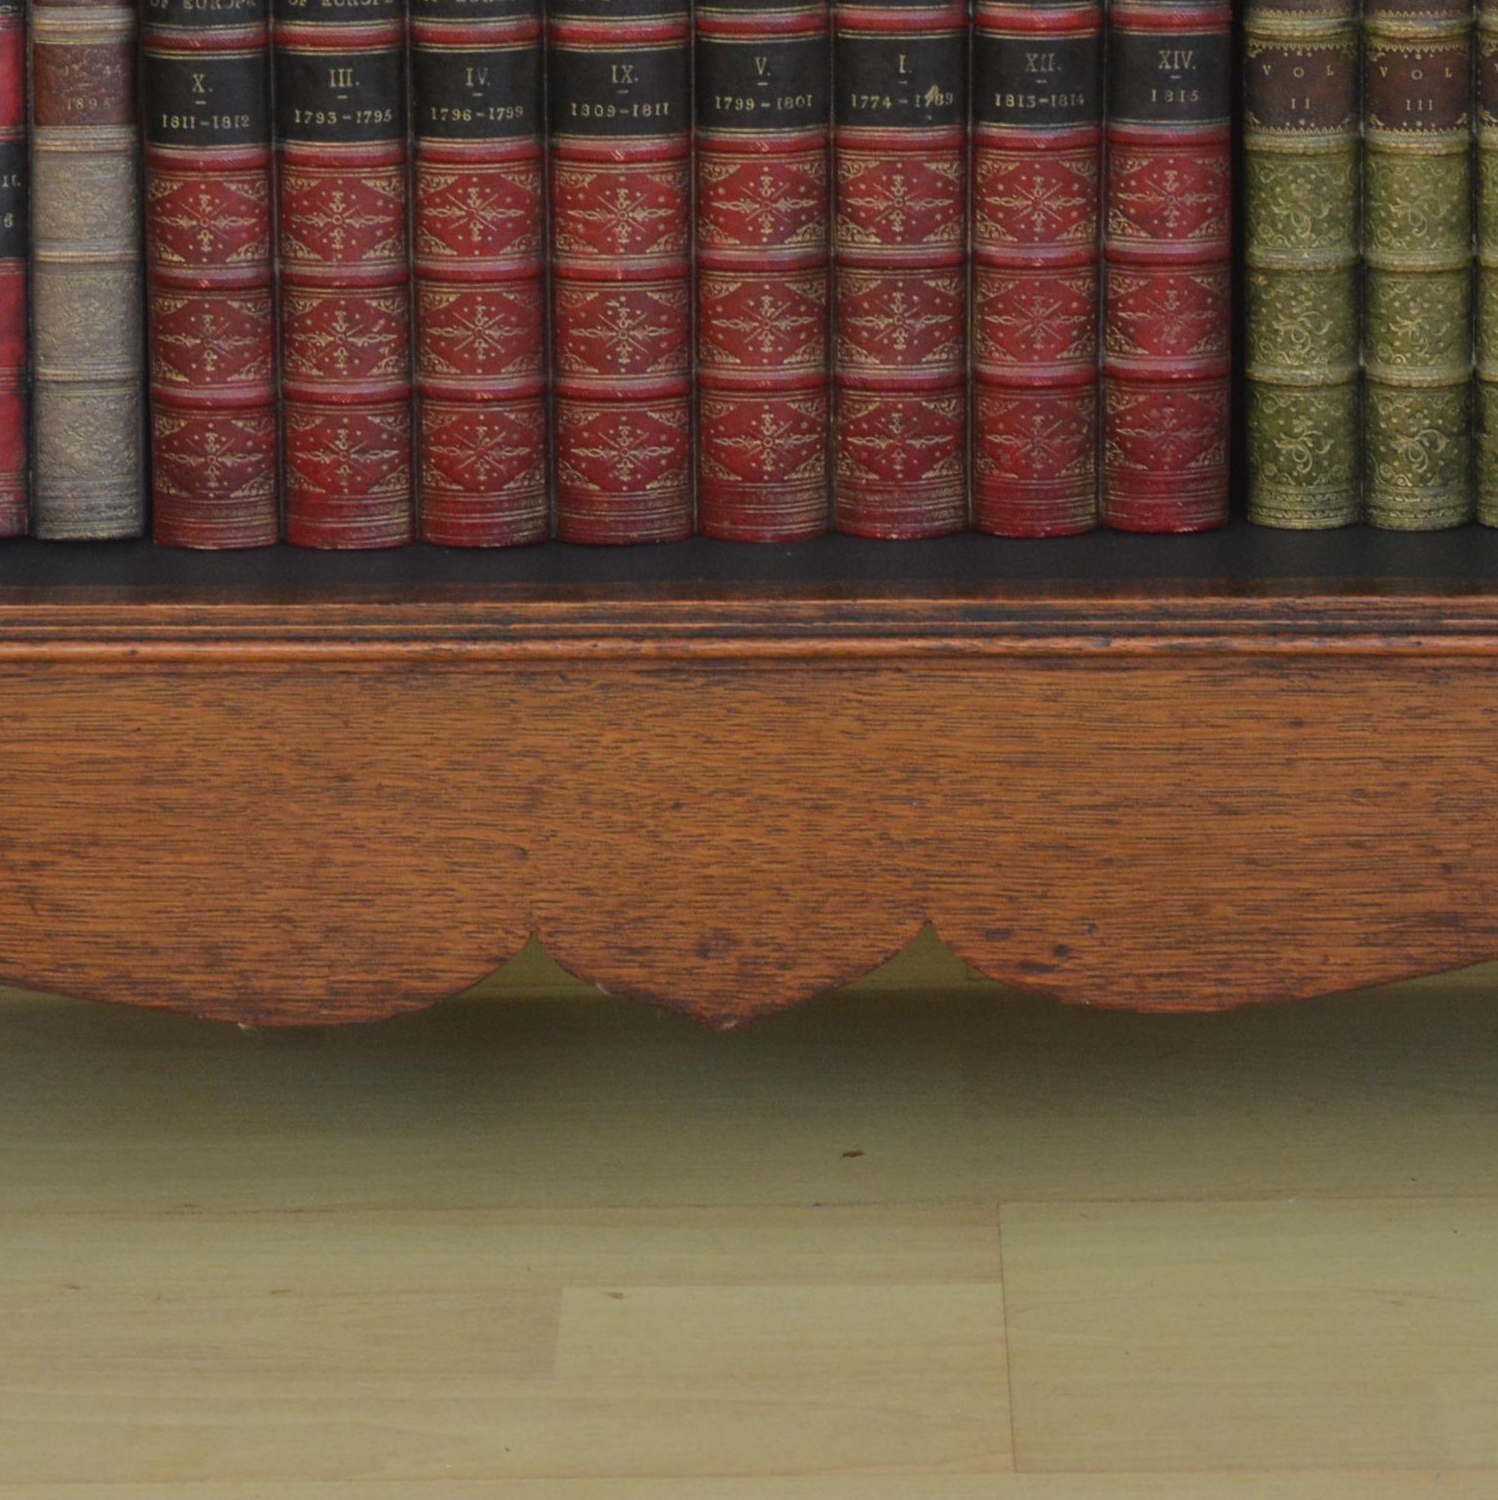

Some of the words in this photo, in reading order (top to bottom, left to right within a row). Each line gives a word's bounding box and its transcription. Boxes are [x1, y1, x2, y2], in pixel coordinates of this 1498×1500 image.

[755, 56, 773, 78] V.
[896, 53, 914, 75] I.
[1024, 51, 1063, 73] XII.
[1157, 49, 1198, 72] XIV.
[328, 68, 361, 89] III.
[464, 67, 493, 88] IV.
[610, 64, 642, 86] IX.
[1261, 64, 1335, 79] VOL
[1378, 65, 1454, 81] VOL
[191, 72, 214, 95] X.
[1148, 88, 1202, 105] 1815
[1290, 97, 1311, 111] II
[1405, 98, 1434, 112] III
